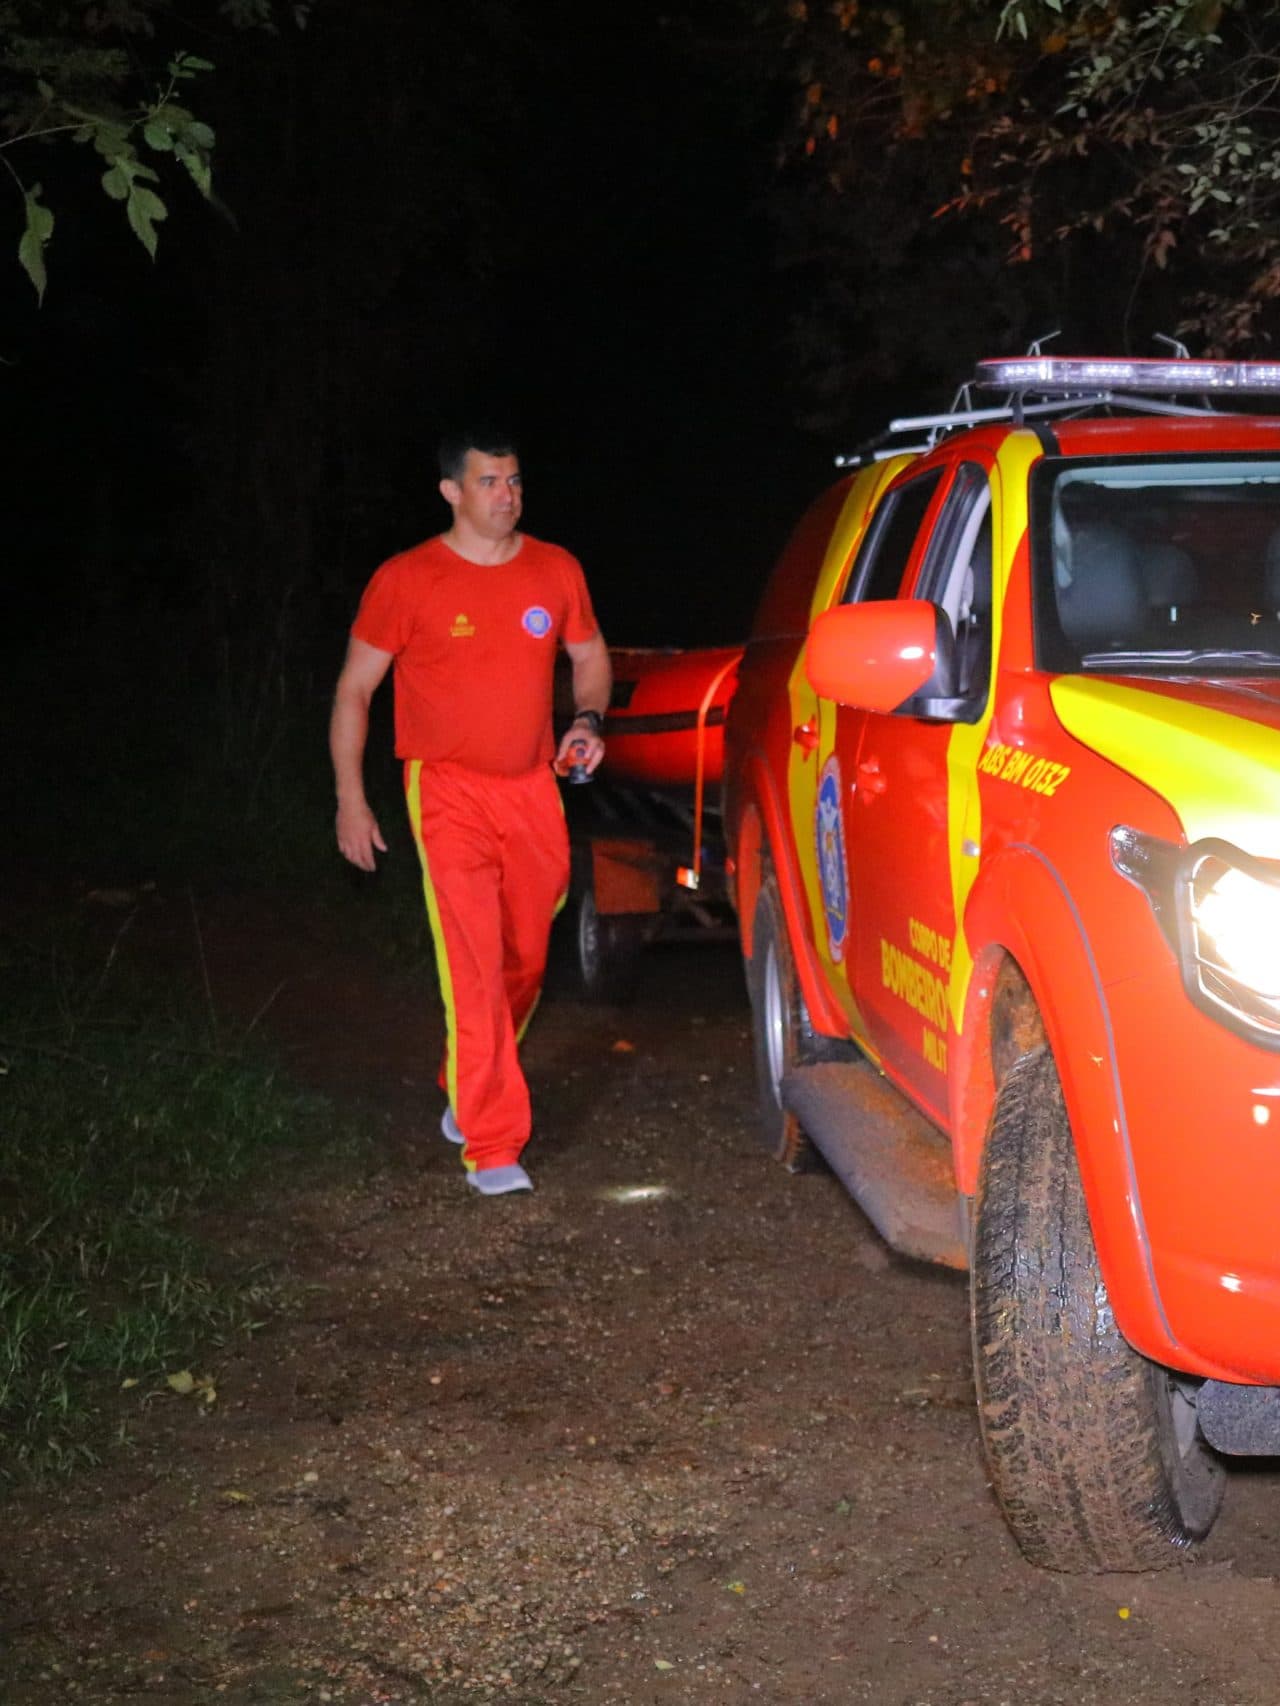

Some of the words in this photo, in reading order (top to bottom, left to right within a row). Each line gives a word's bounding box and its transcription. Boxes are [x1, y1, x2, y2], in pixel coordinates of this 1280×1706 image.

[1000, 750, 1035, 785] BM
[1022, 757, 1071, 797] 0132
[909, 916, 938, 964] CORPO
[937, 934, 951, 973] DE
[880, 937, 950, 1033] BOMBEIRO
